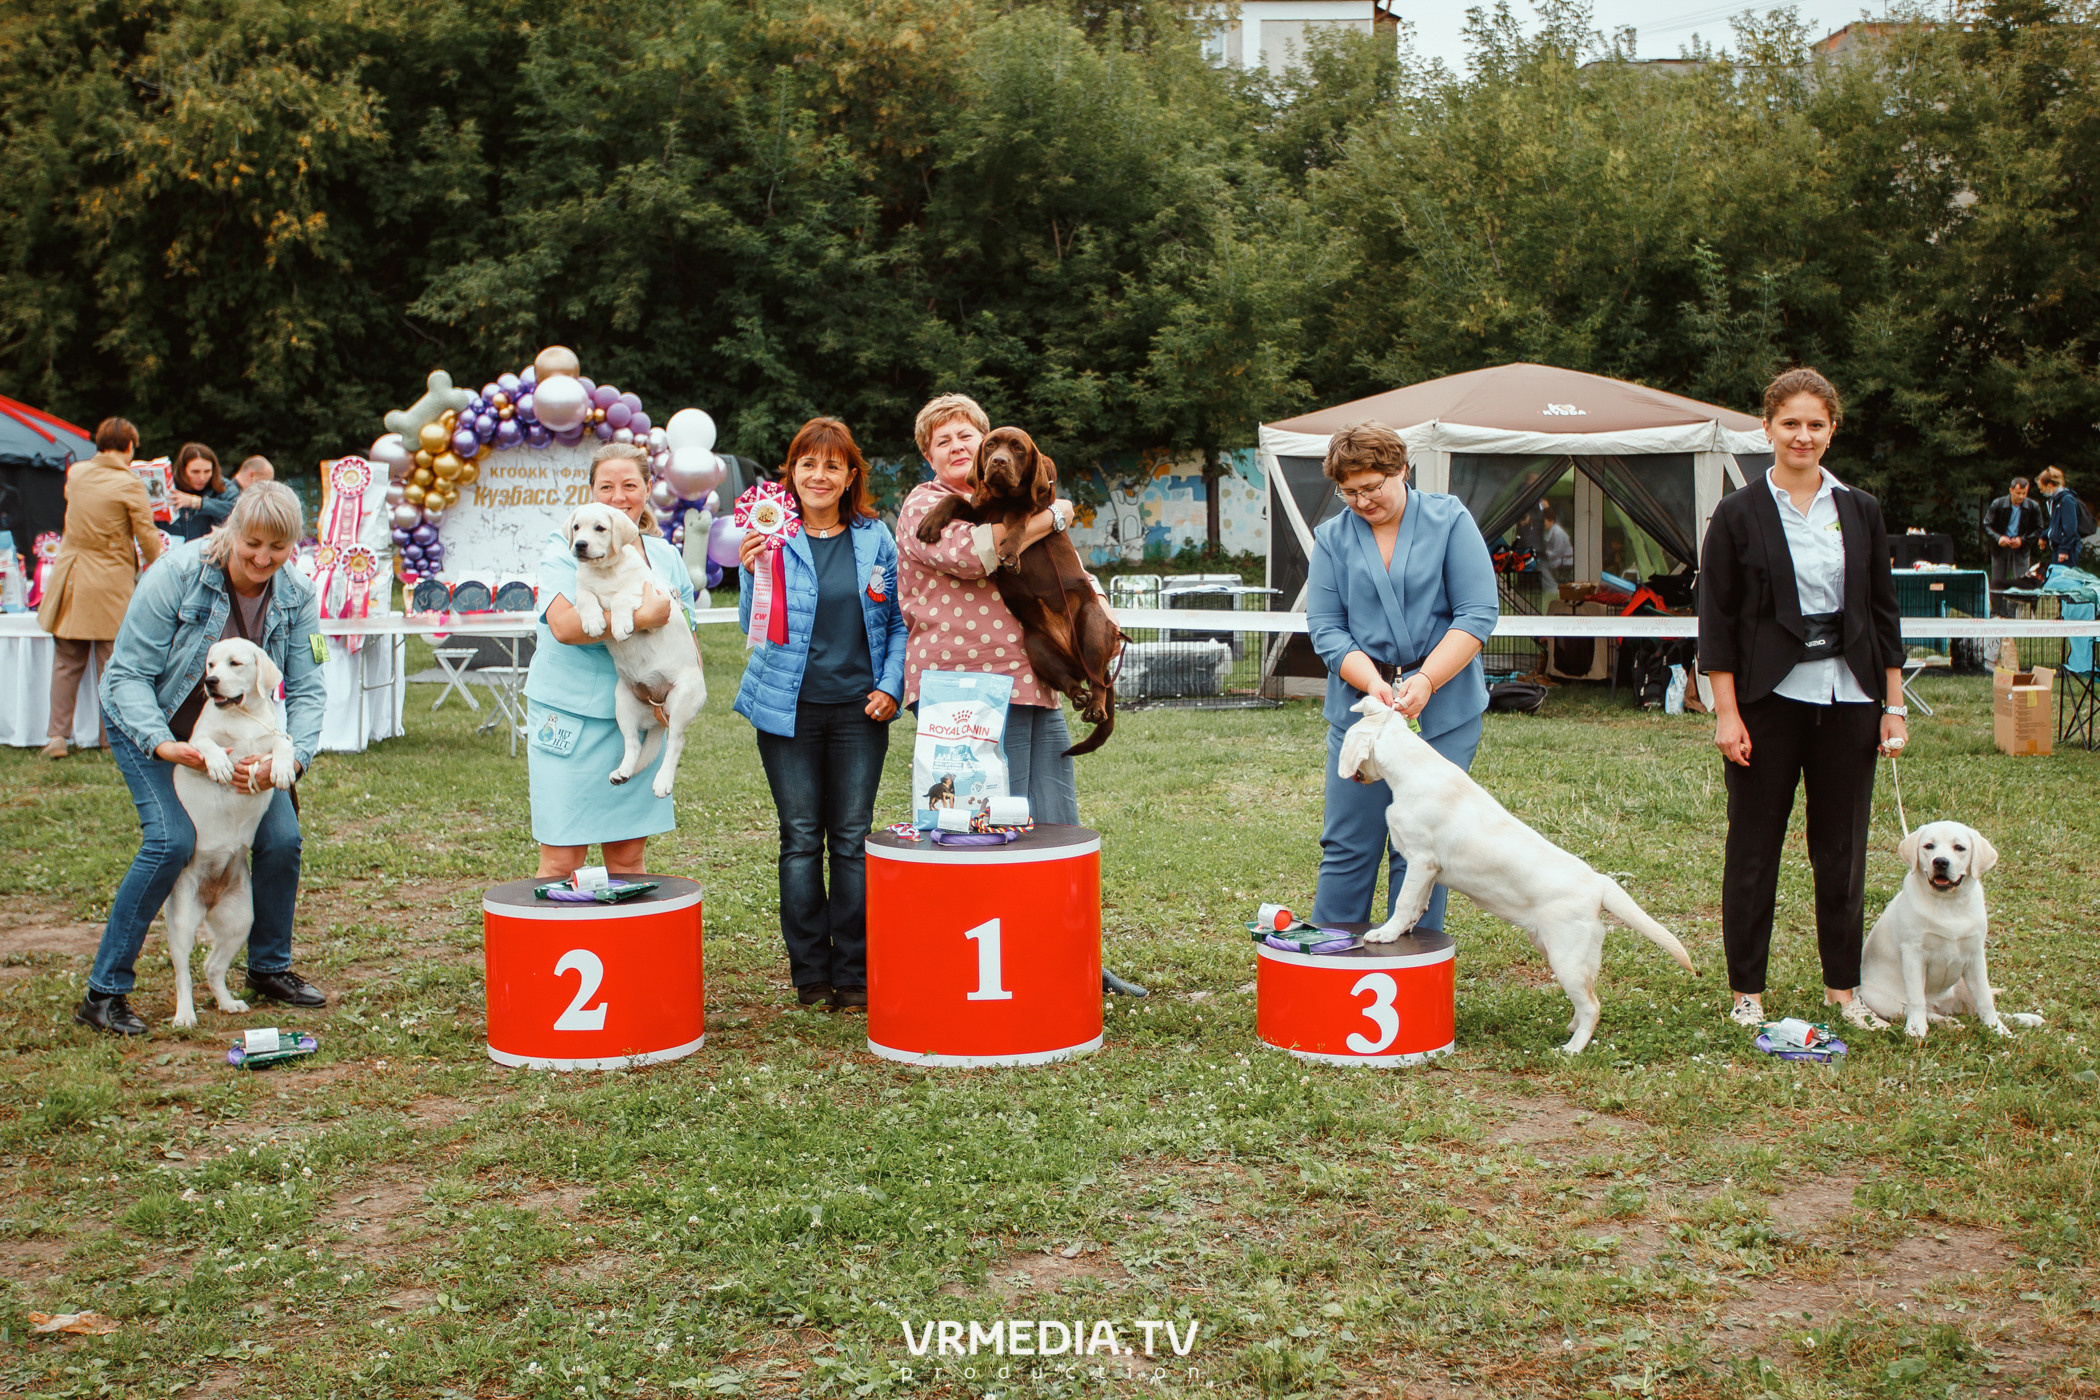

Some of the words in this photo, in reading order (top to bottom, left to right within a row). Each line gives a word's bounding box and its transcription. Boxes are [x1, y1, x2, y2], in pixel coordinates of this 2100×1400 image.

[490, 467, 548, 479] КГООКК
[474, 485, 559, 508] Кузбасс
[563, 484, 591, 506] 20
[929, 723, 960, 736] ROYAL
[962, 723, 990, 736] CANIN
[553, 739, 570, 748] HIT
[964, 917, 1013, 1001] 1
[553, 948, 608, 1031] 2
[1346, 972, 1399, 1054] 3
